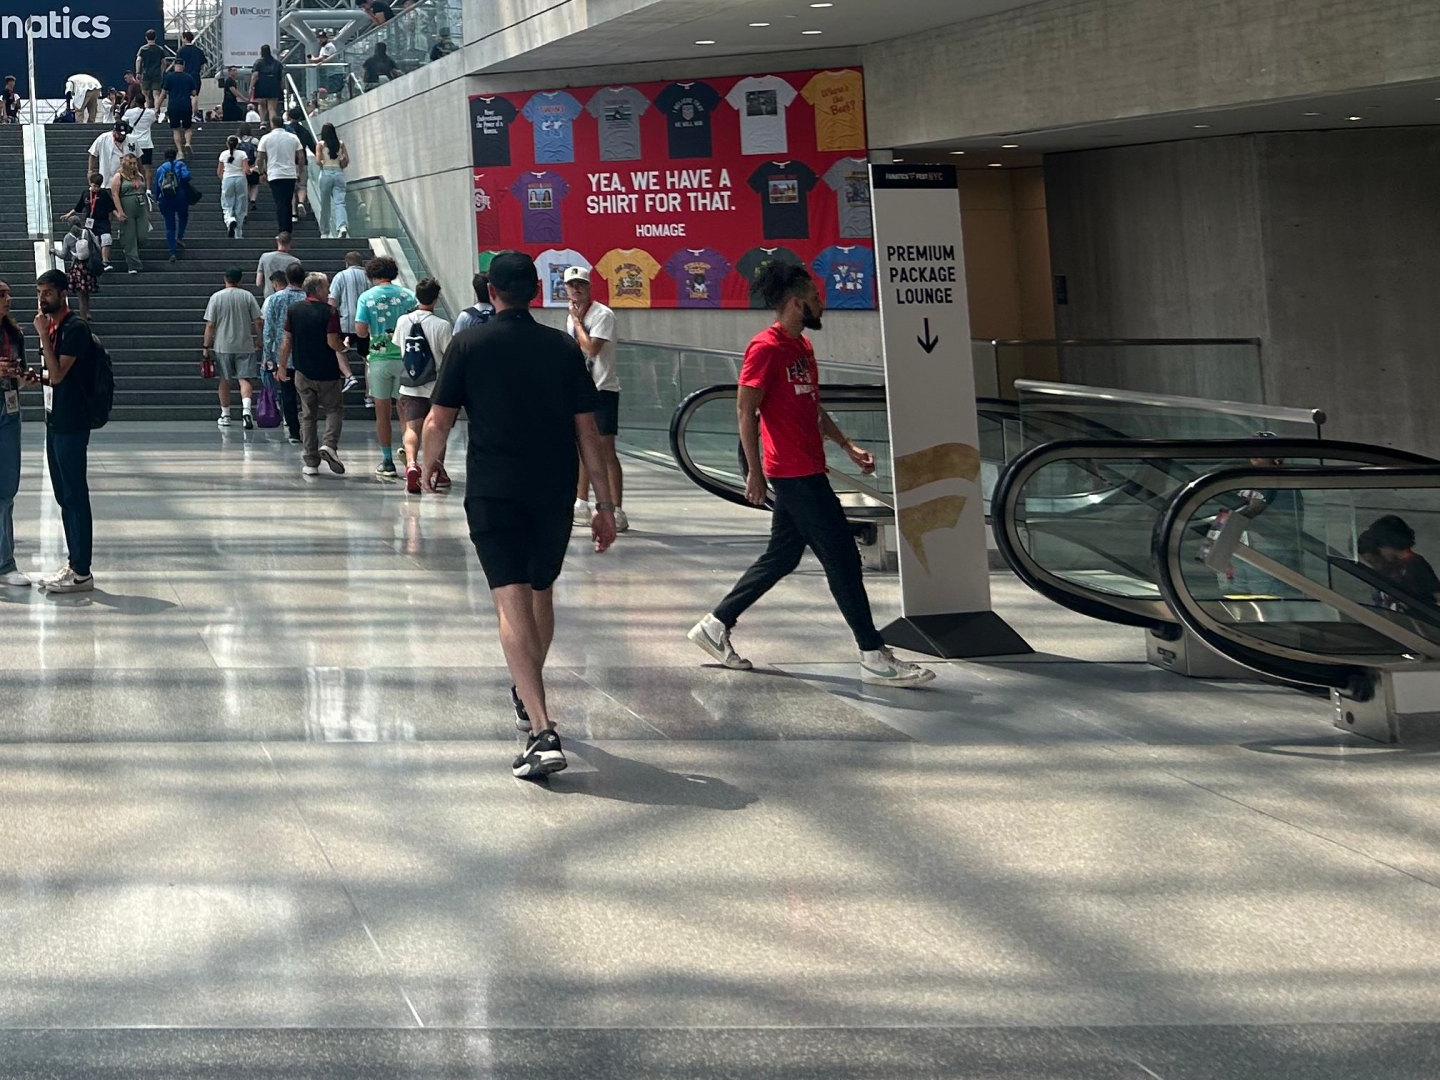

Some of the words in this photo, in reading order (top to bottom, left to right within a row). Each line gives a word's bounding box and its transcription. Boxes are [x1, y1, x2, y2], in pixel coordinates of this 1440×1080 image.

[587, 172, 626, 193] YEA,
[630, 170, 659, 191] WE
[666, 169, 714, 190] HAVE
[718, 168, 731, 188] A
[927, 172, 944, 181] NYC
[586, 193, 638, 214] SHIRT
[645, 192, 680, 212] FOR
[687, 191, 736, 211] THAT.
[635, 223, 686, 237] HOMAGE
[886, 245, 955, 261] PREMIUM
[889, 266, 957, 283] PACKAGE
[896, 287, 953, 304] LOUNGE
